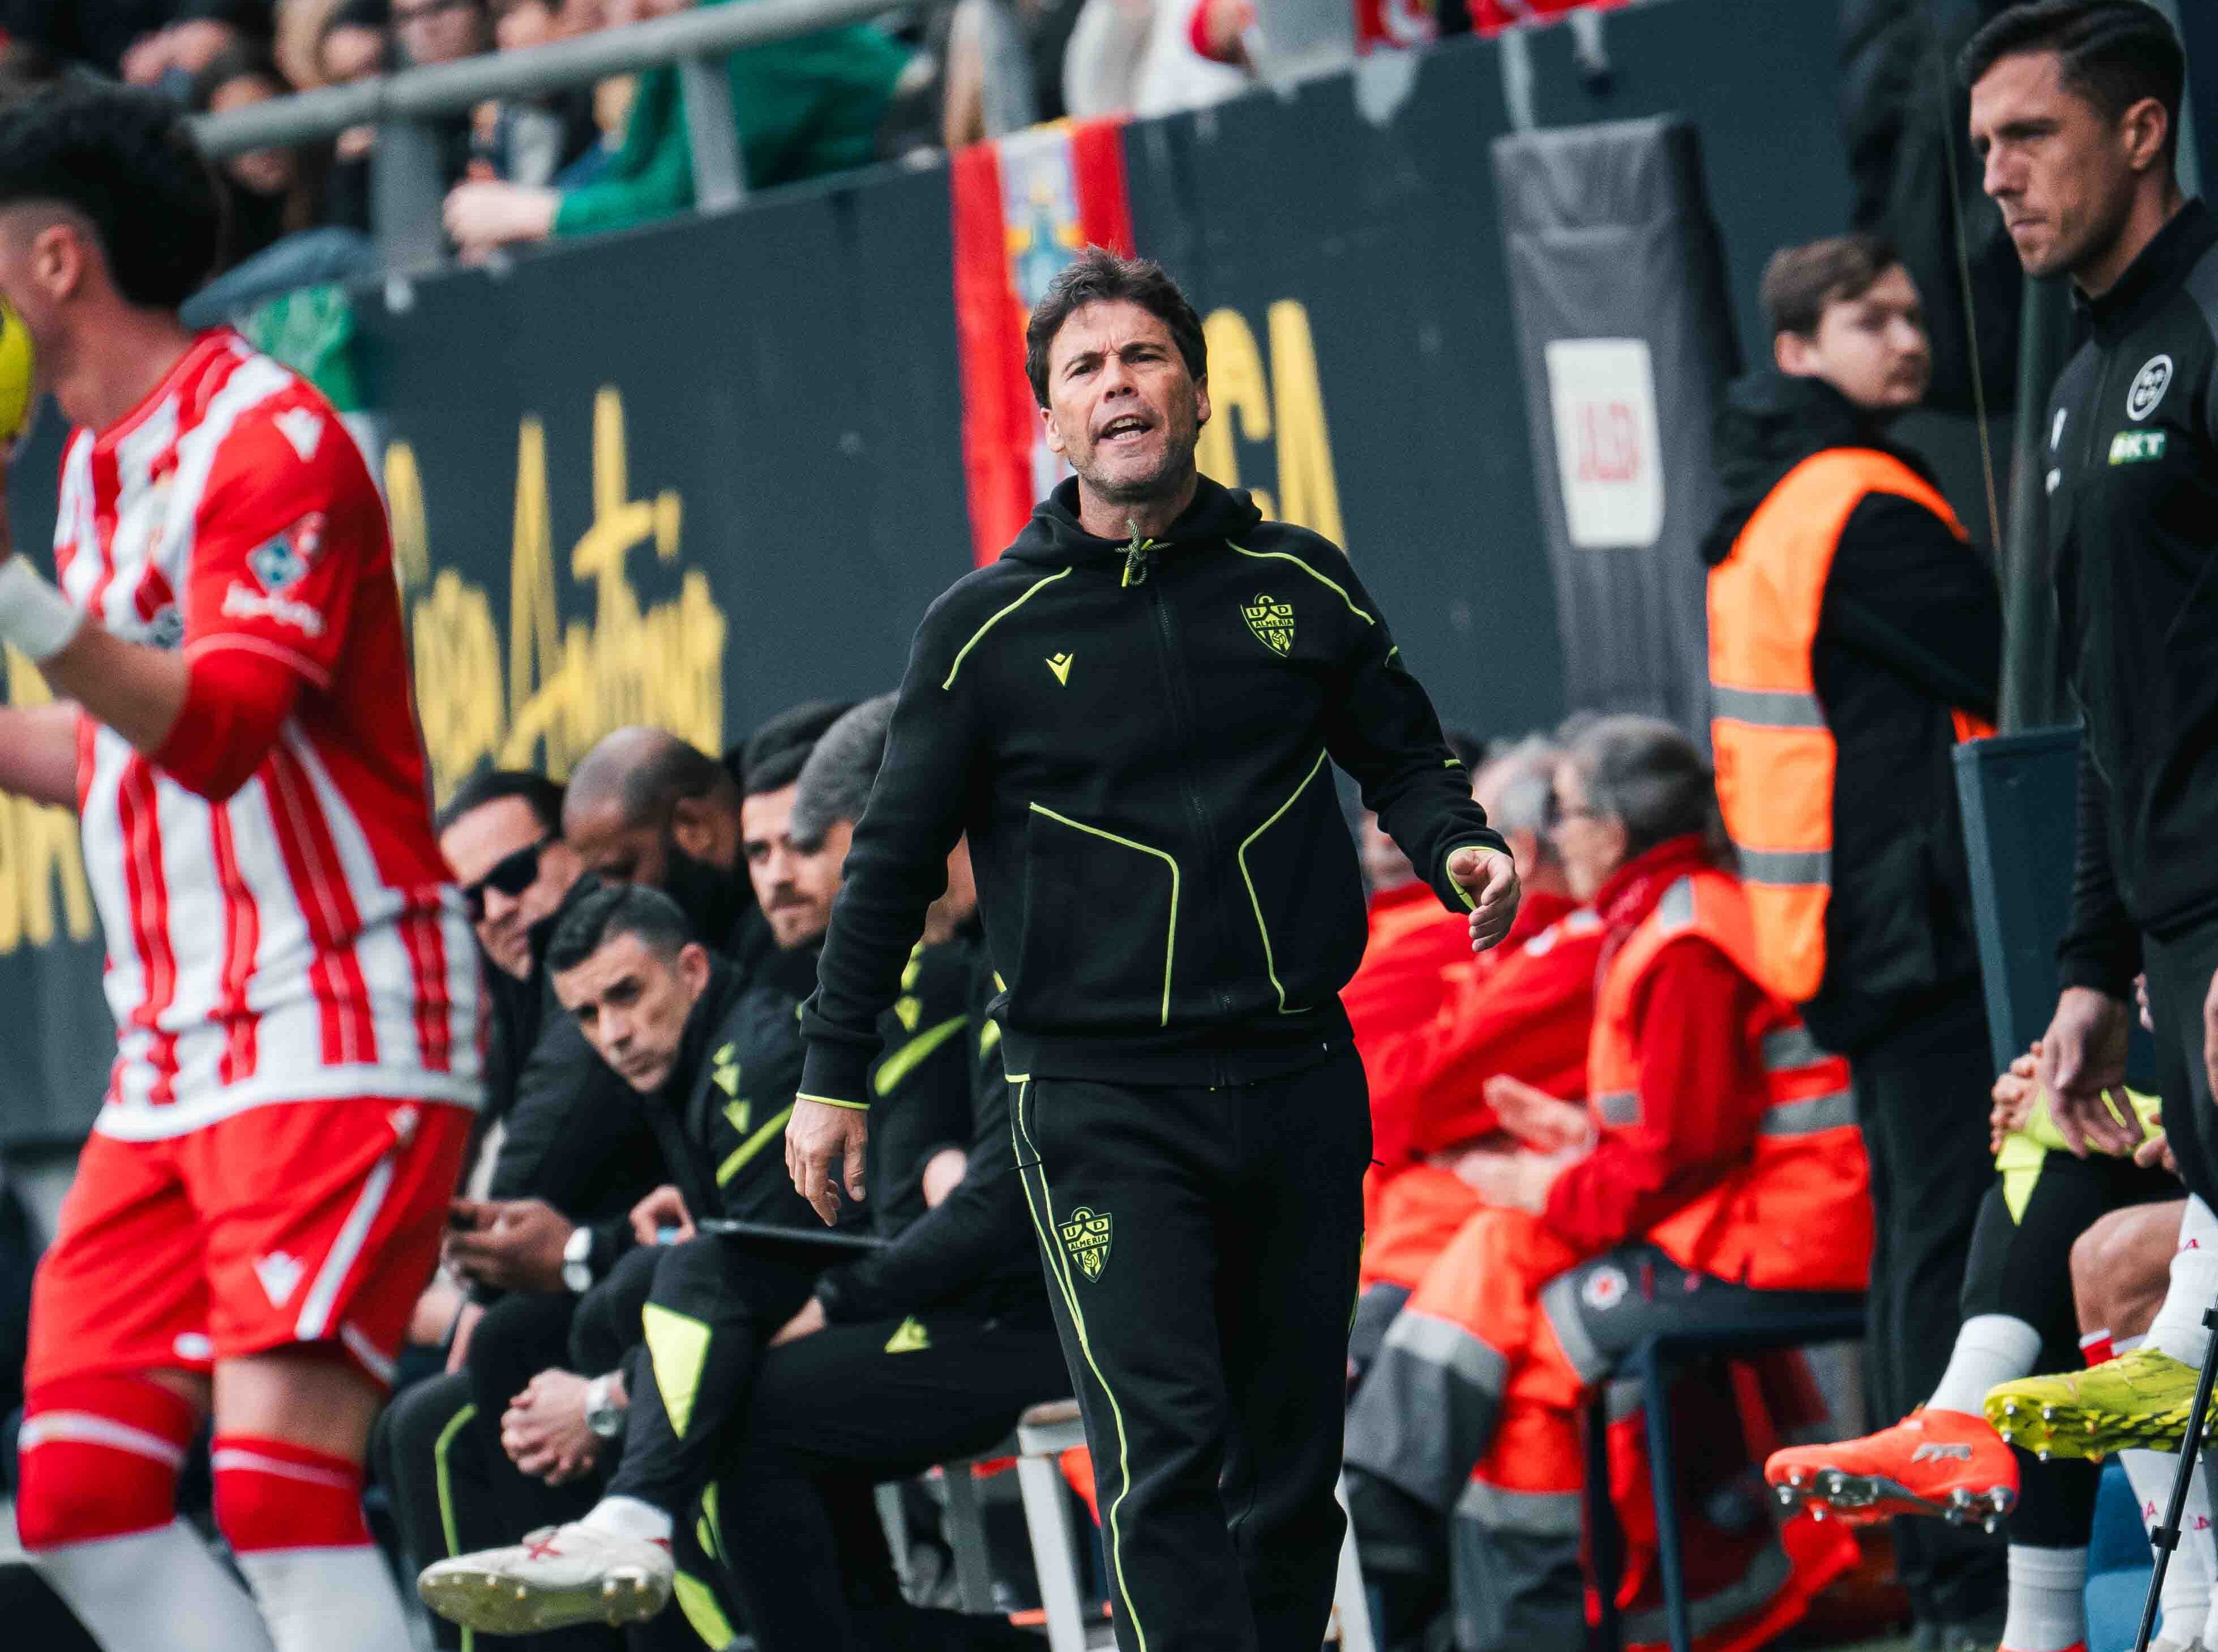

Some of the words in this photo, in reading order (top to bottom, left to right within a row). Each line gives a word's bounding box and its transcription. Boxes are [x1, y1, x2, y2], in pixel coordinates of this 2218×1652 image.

[1277, 606, 1289, 614] D
[1256, 619, 1293, 628] ALMERIA
[1066, 1227, 1076, 1237] U
[1093, 1221, 1104, 1230] D
[1071, 1235, 1107, 1250] ALMERIA
